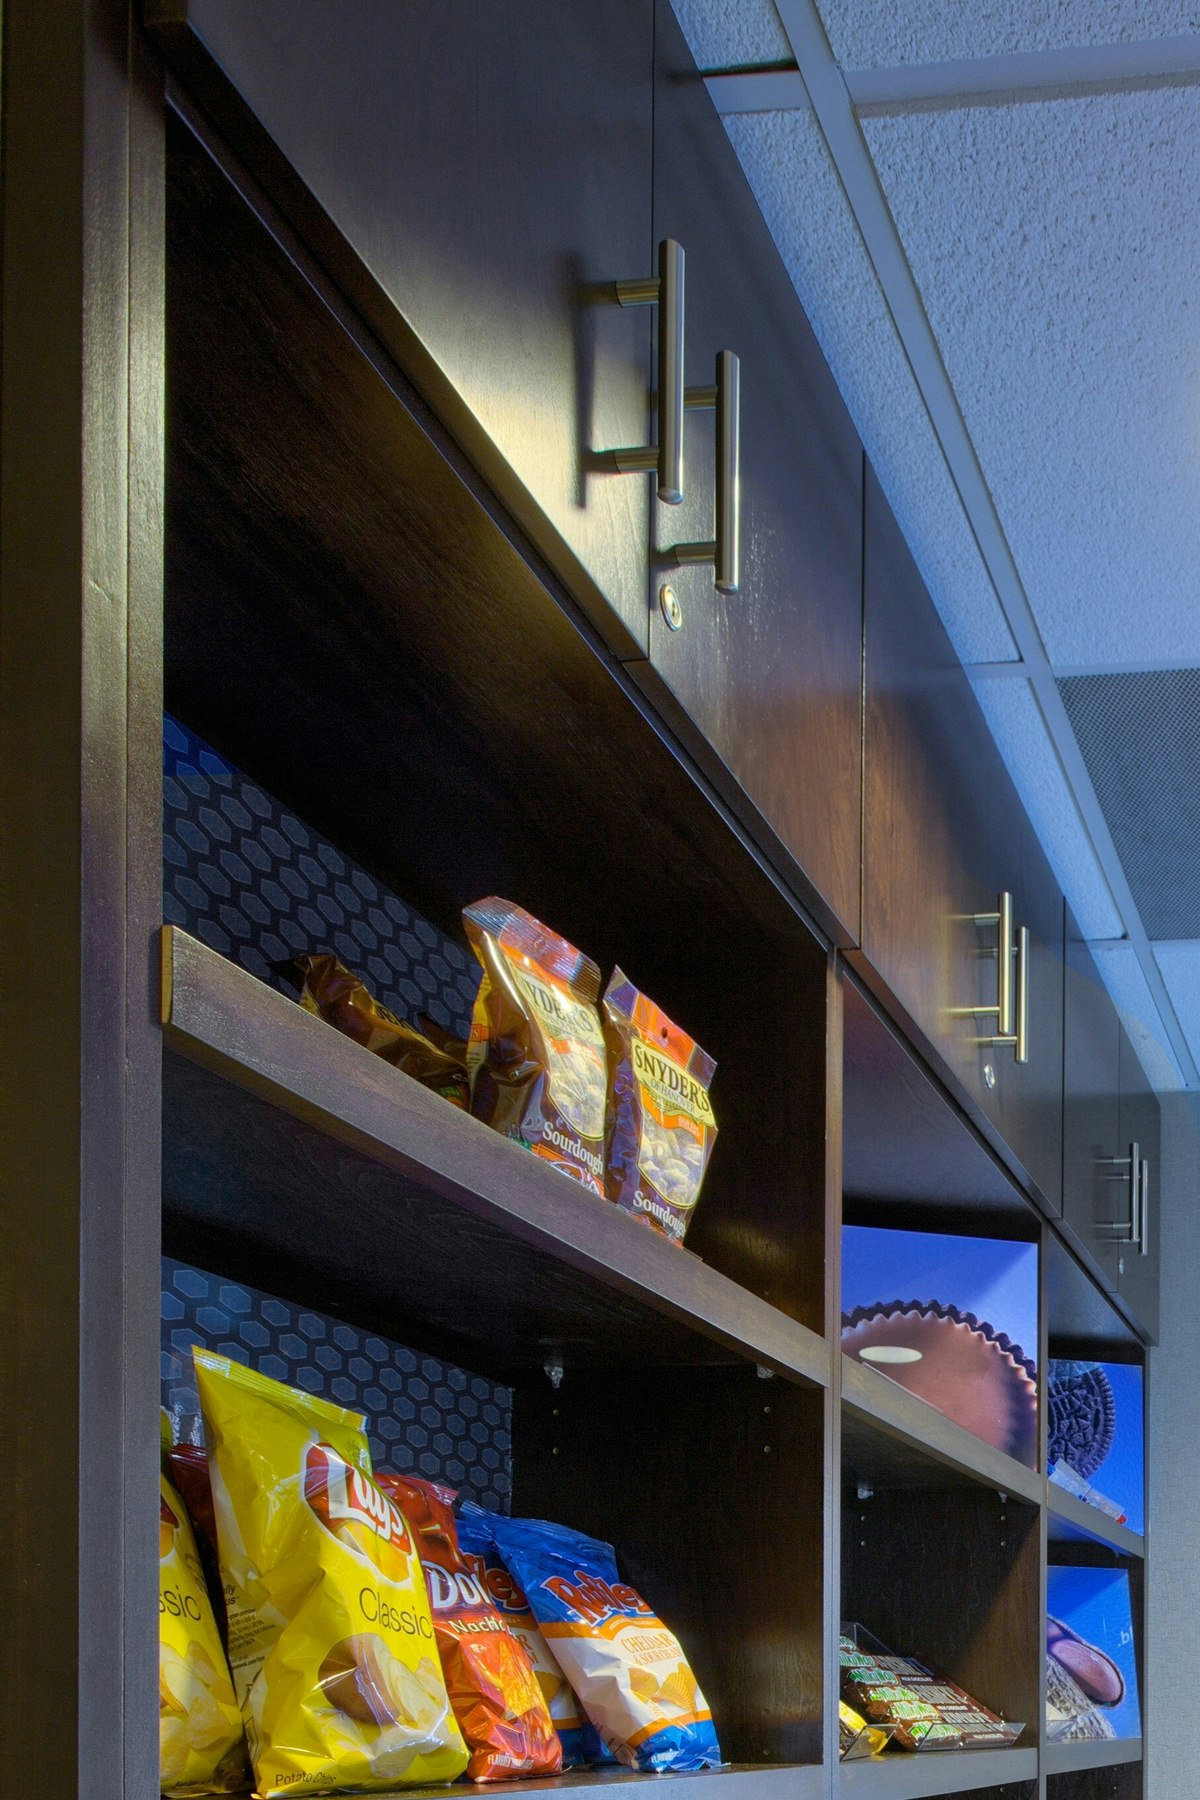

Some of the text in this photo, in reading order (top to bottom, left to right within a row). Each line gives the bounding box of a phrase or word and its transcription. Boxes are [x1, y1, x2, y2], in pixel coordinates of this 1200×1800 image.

[634, 1044, 710, 1112] SNYDER'S
[543, 1121, 603, 1175] Sourdough
[160, 1585, 201, 1621] ssic
[359, 1587, 433, 1639] Classic
[275, 1771, 312, 1787] Potato
